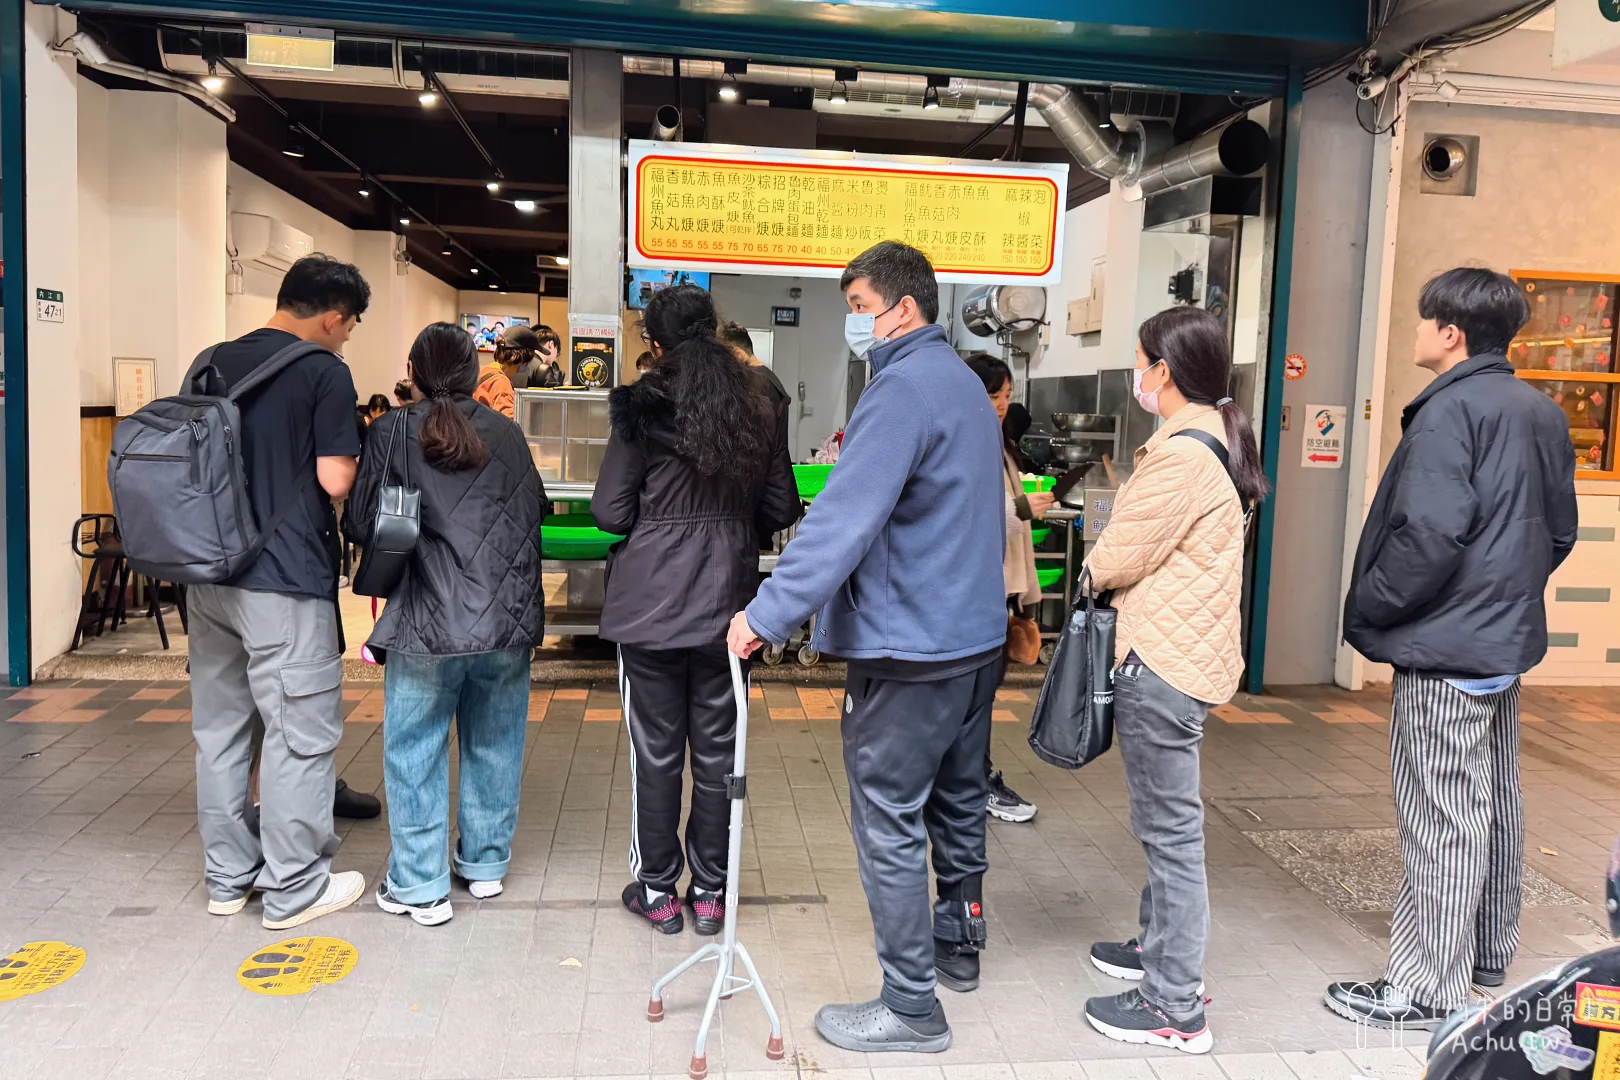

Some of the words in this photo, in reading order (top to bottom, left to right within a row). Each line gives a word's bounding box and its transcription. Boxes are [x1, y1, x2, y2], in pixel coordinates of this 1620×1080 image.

[651, 167, 664, 230] 福州魚丸
[666, 169, 679, 231] 香菇丸
[681, 169, 695, 232] 魷魚焿
[697, 171, 710, 233] 赤肉焿
[711, 171, 725, 234] 魚酥焿
[727, 172, 740, 223] 魚皮焿
[742, 173, 755, 224] 沙茶魷魚
[757, 174, 771, 236] 粽合焿
[771, 174, 786, 237] 招牌焿
[801, 176, 815, 238] 乾油麵
[815, 177, 830, 239] 福州乾麵
[844, 179, 859, 240] 米粉炒
[860, 180, 873, 240] 魯肉飯
[903, 182, 917, 243] 福州魚丸
[917, 183, 932, 244] 魷魚焿
[931, 183, 946, 245] 香菇丸
[945, 184, 960, 245] 赤肉焿
[651, 238, 663, 247] 55
[666, 239, 678, 248] 55
[682, 240, 694, 249] 55
[697, 240, 709, 250] 55
[712, 241, 724, 250] 55
[727, 242, 739, 251] 75
[742, 243, 754, 252] 70
[757, 243, 769, 252] 65
[772, 244, 783, 253] 75
[787, 245, 798, 254] 70
[801, 245, 812, 254] 40
[815, 246, 827, 255] 40
[830, 246, 842, 255] 50
[844, 247, 856, 256] 45
[1306, 438, 1339, 448] 防空避難
